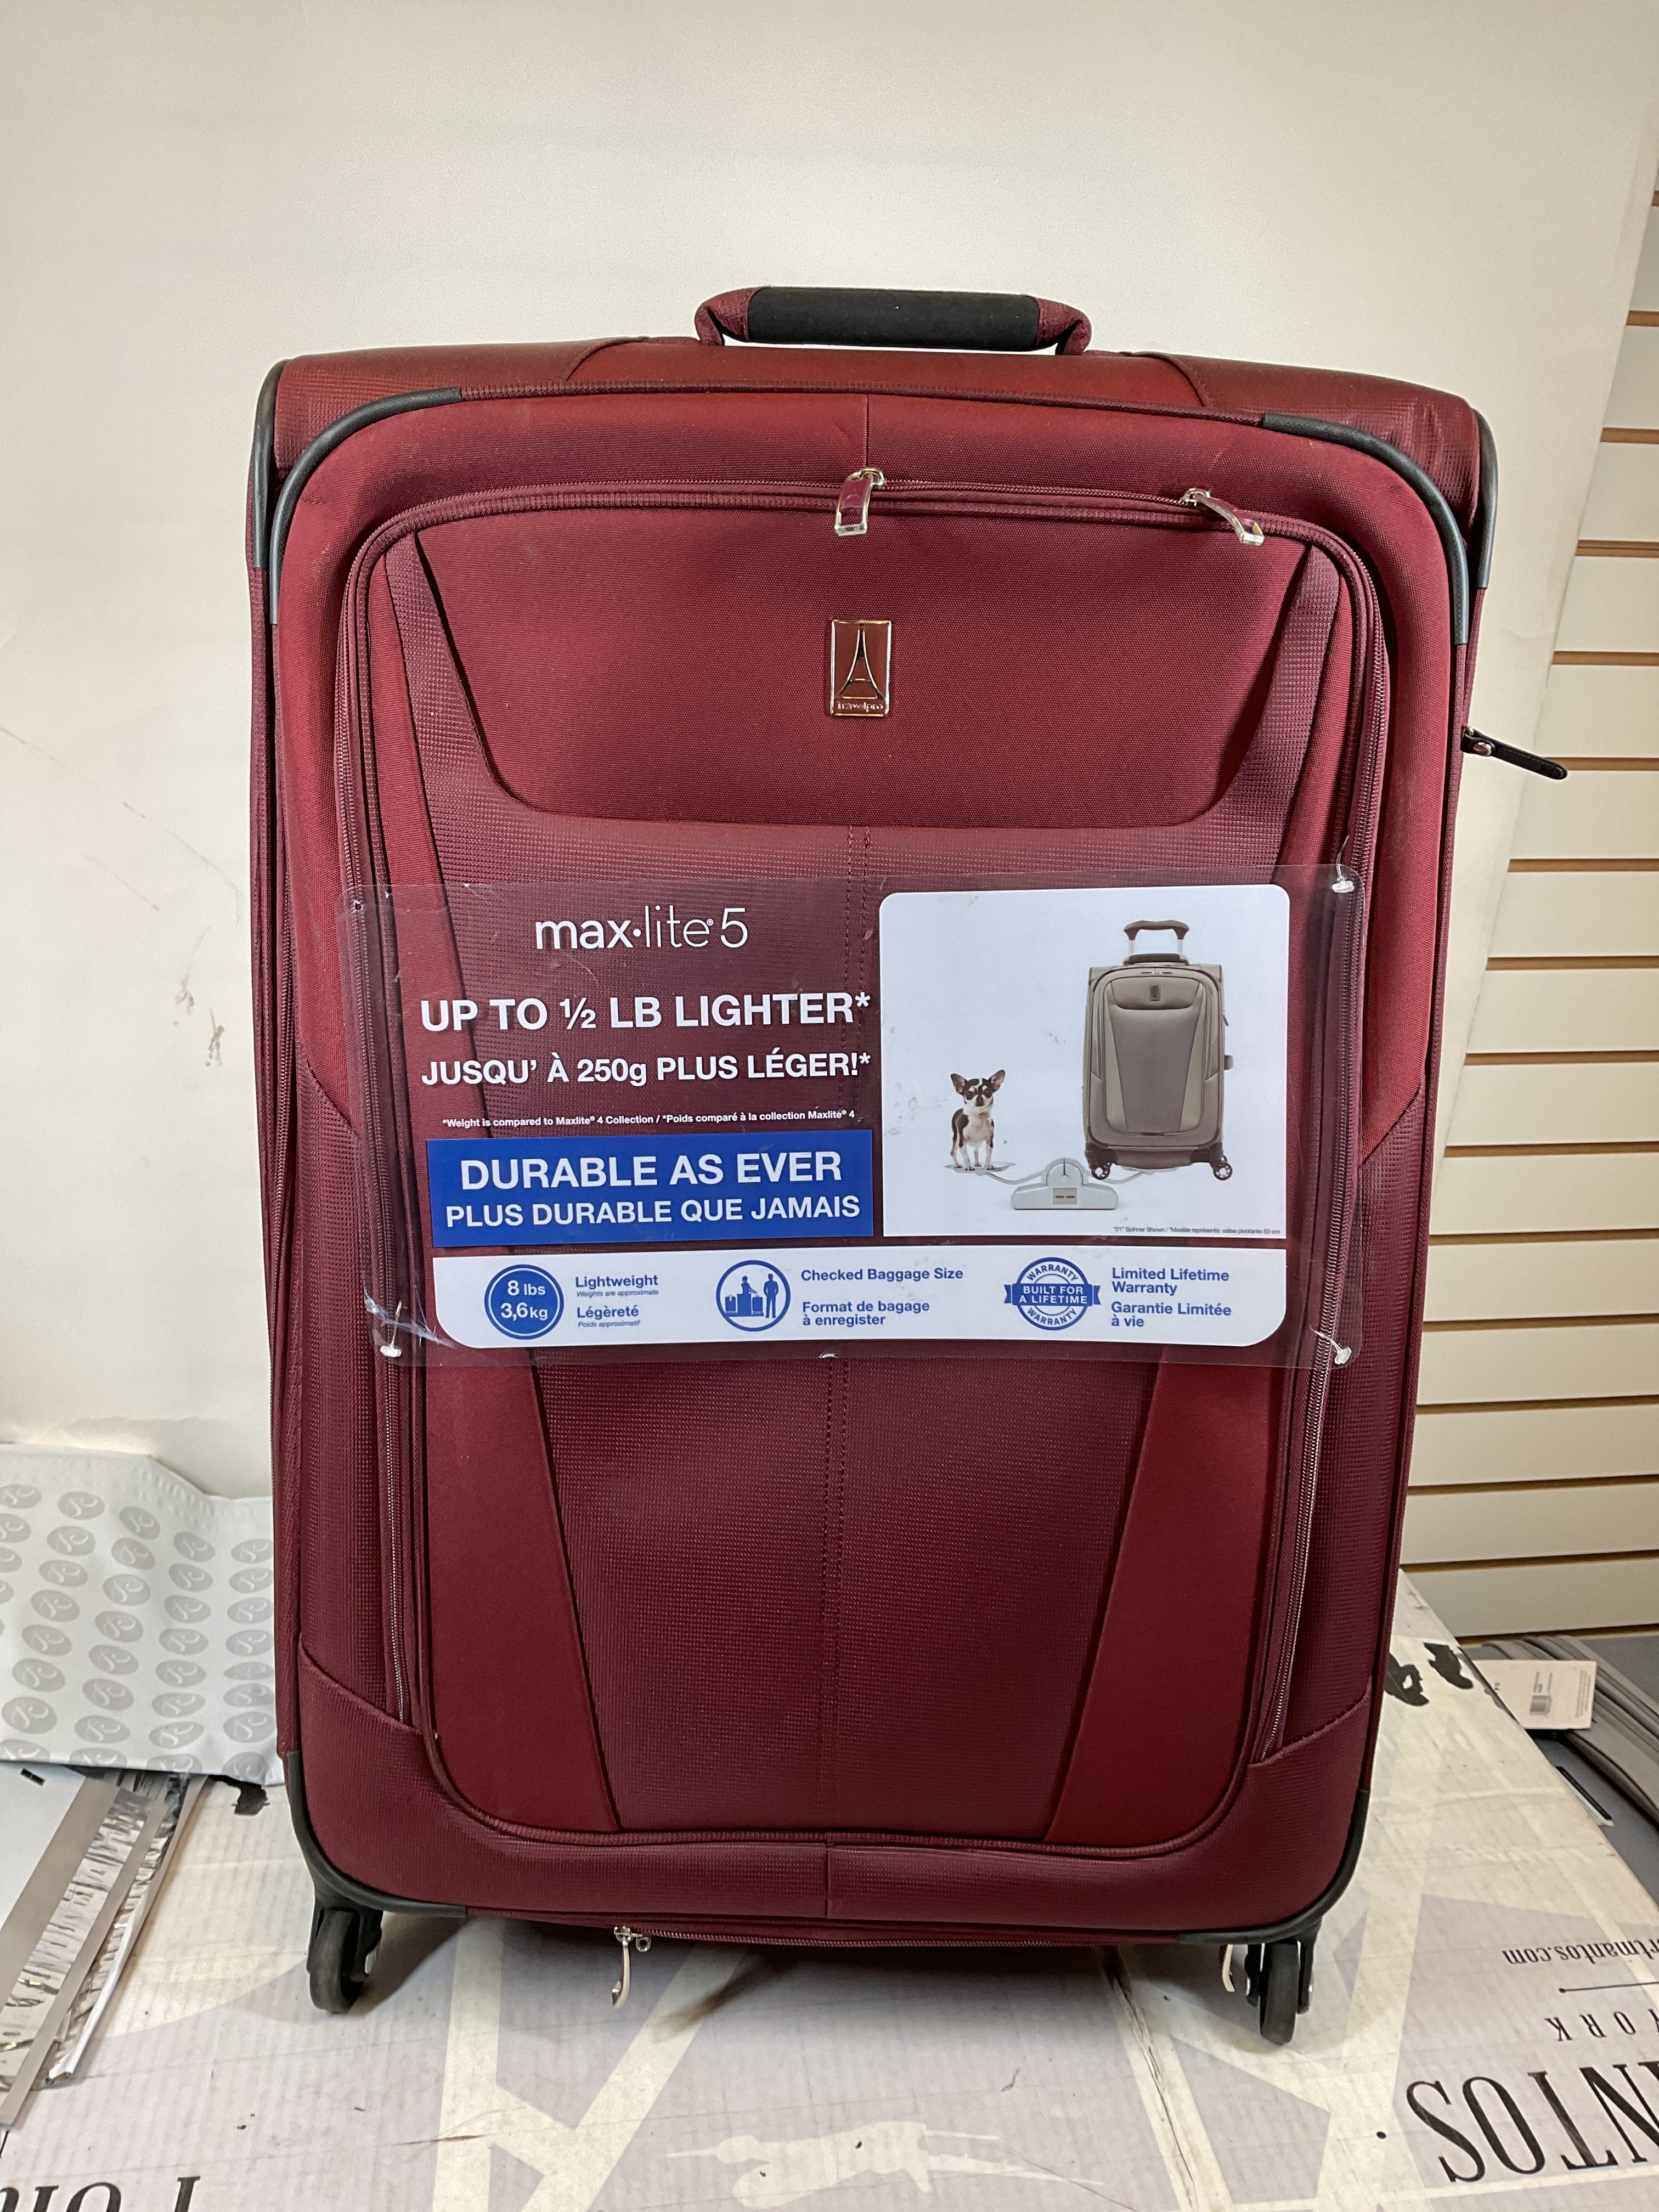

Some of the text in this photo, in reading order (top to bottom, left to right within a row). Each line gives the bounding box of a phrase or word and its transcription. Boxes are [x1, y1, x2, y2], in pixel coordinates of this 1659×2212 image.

[421, 999, 476, 1031] UP
[489, 998, 548, 1030] TO
[611, 996, 662, 1029] LB
[547, 1052, 568, 1083] À
[577, 1058, 647, 1087] 250g
[657, 1055, 738, 1080] PLUS
[482, 1118, 490, 1127] is
[493, 1118, 541, 1127] compared
[606, 1115, 653, 1125] Collection
[656, 1115, 661, 1123] /
[696, 1113, 738, 1123] comparé
[740, 1112, 747, 1121] à
[749, 1113, 757, 1121] la
[759, 1111, 805, 1121] collection
[461, 1152, 841, 1190] DURABLE AS EVER
[445, 1196, 860, 1228] PLUS DURABLE QUE JAMAIS
[801, 1267, 964, 1282] Checked Baggage Size
[1026, 1263, 1079, 1282] WARRANTY
[1111, 1267, 1229, 1282] Limited Lifetime
[507, 1279, 546, 1296] 8 lbs
[575, 1274, 659, 1289] Lightweight
[1112, 1280, 1177, 1296] Warranty
[617, 1289, 659, 1298] approximate
[1023, 1285, 1083, 1295] BUILT FOR
[1019, 1295, 1087, 1304] A LIFETIME
[577, 1305, 639, 1320] Légèreté
[803, 1301, 930, 1314] Format de bagage
[1111, 1301, 1232, 1316] Garantie Limitée
[599, 1320, 641, 1328] approximatif
[803, 1314, 886, 1328] à enregister
[1026, 1307, 1078, 1326] WARRANTY
[1111, 1314, 1144, 1327] à vie
[1502, 1938, 1659, 1965] rtmantos.com
[1406, 2061, 1659, 2182] NTOS
